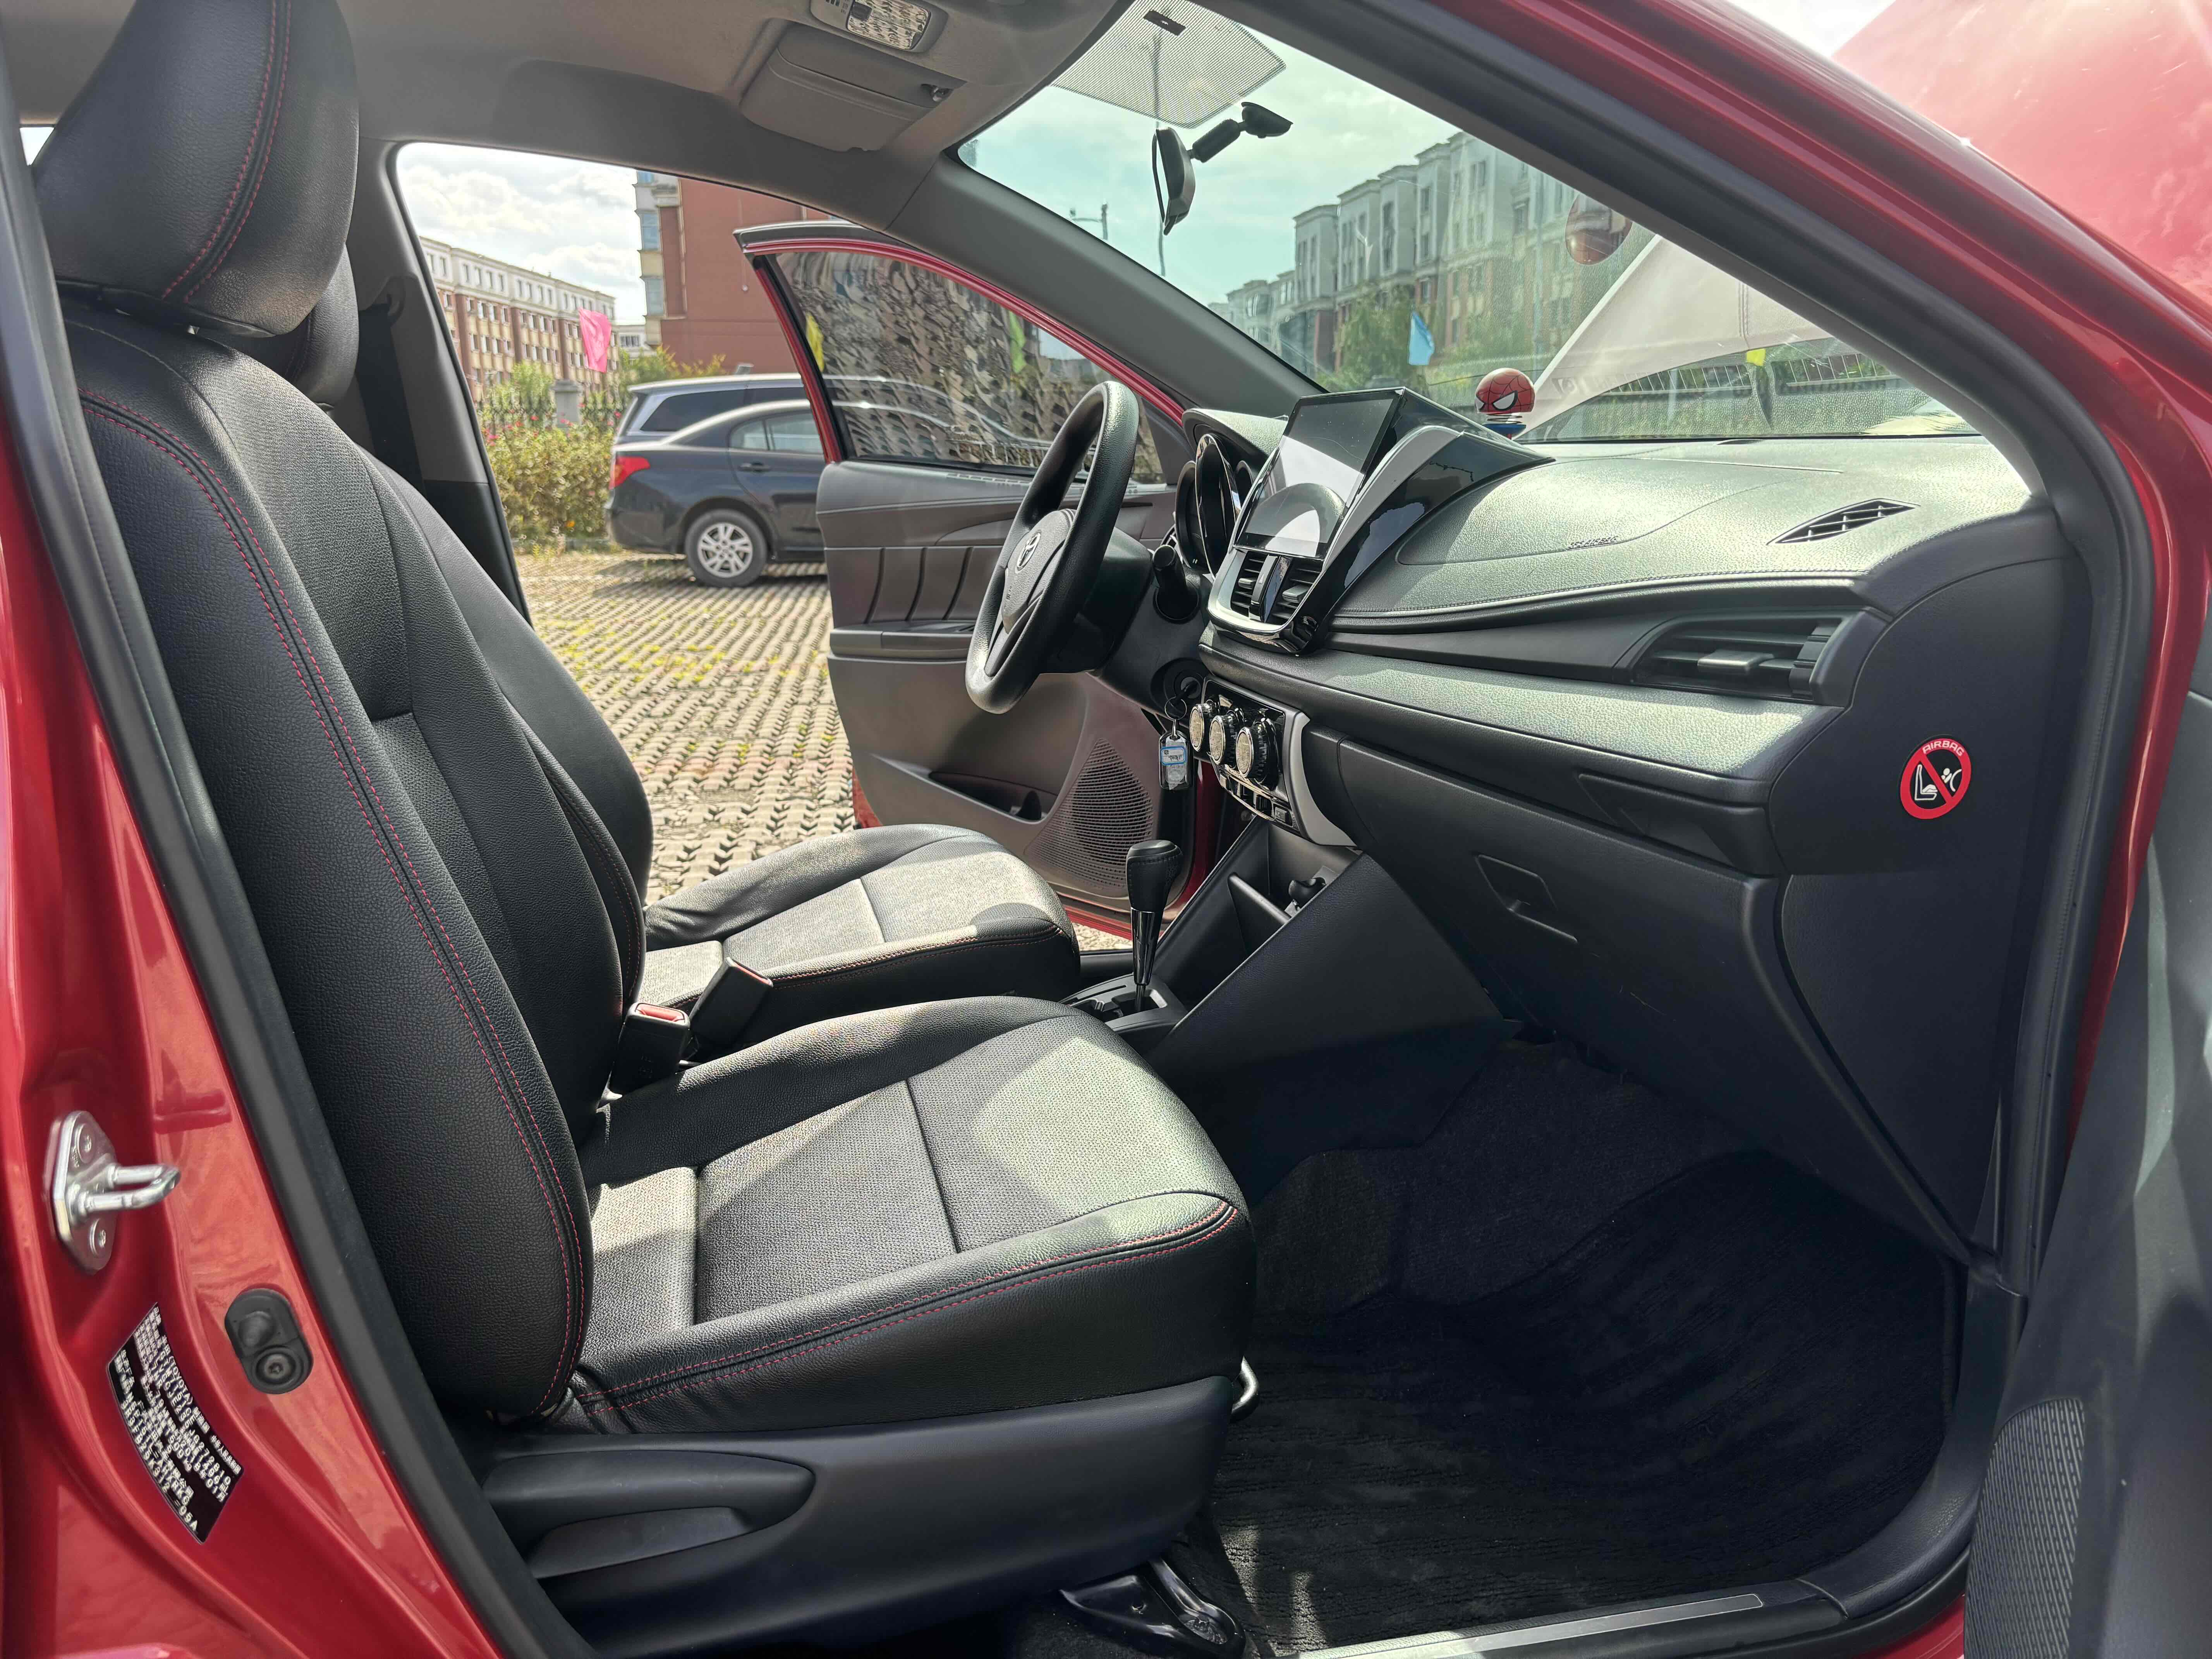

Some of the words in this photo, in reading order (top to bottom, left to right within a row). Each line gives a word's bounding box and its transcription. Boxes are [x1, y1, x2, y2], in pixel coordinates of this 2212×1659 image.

[1922, 740, 1965, 756] AIRBAG
[210, 1433, 241, 1475] 中华人民共和国
